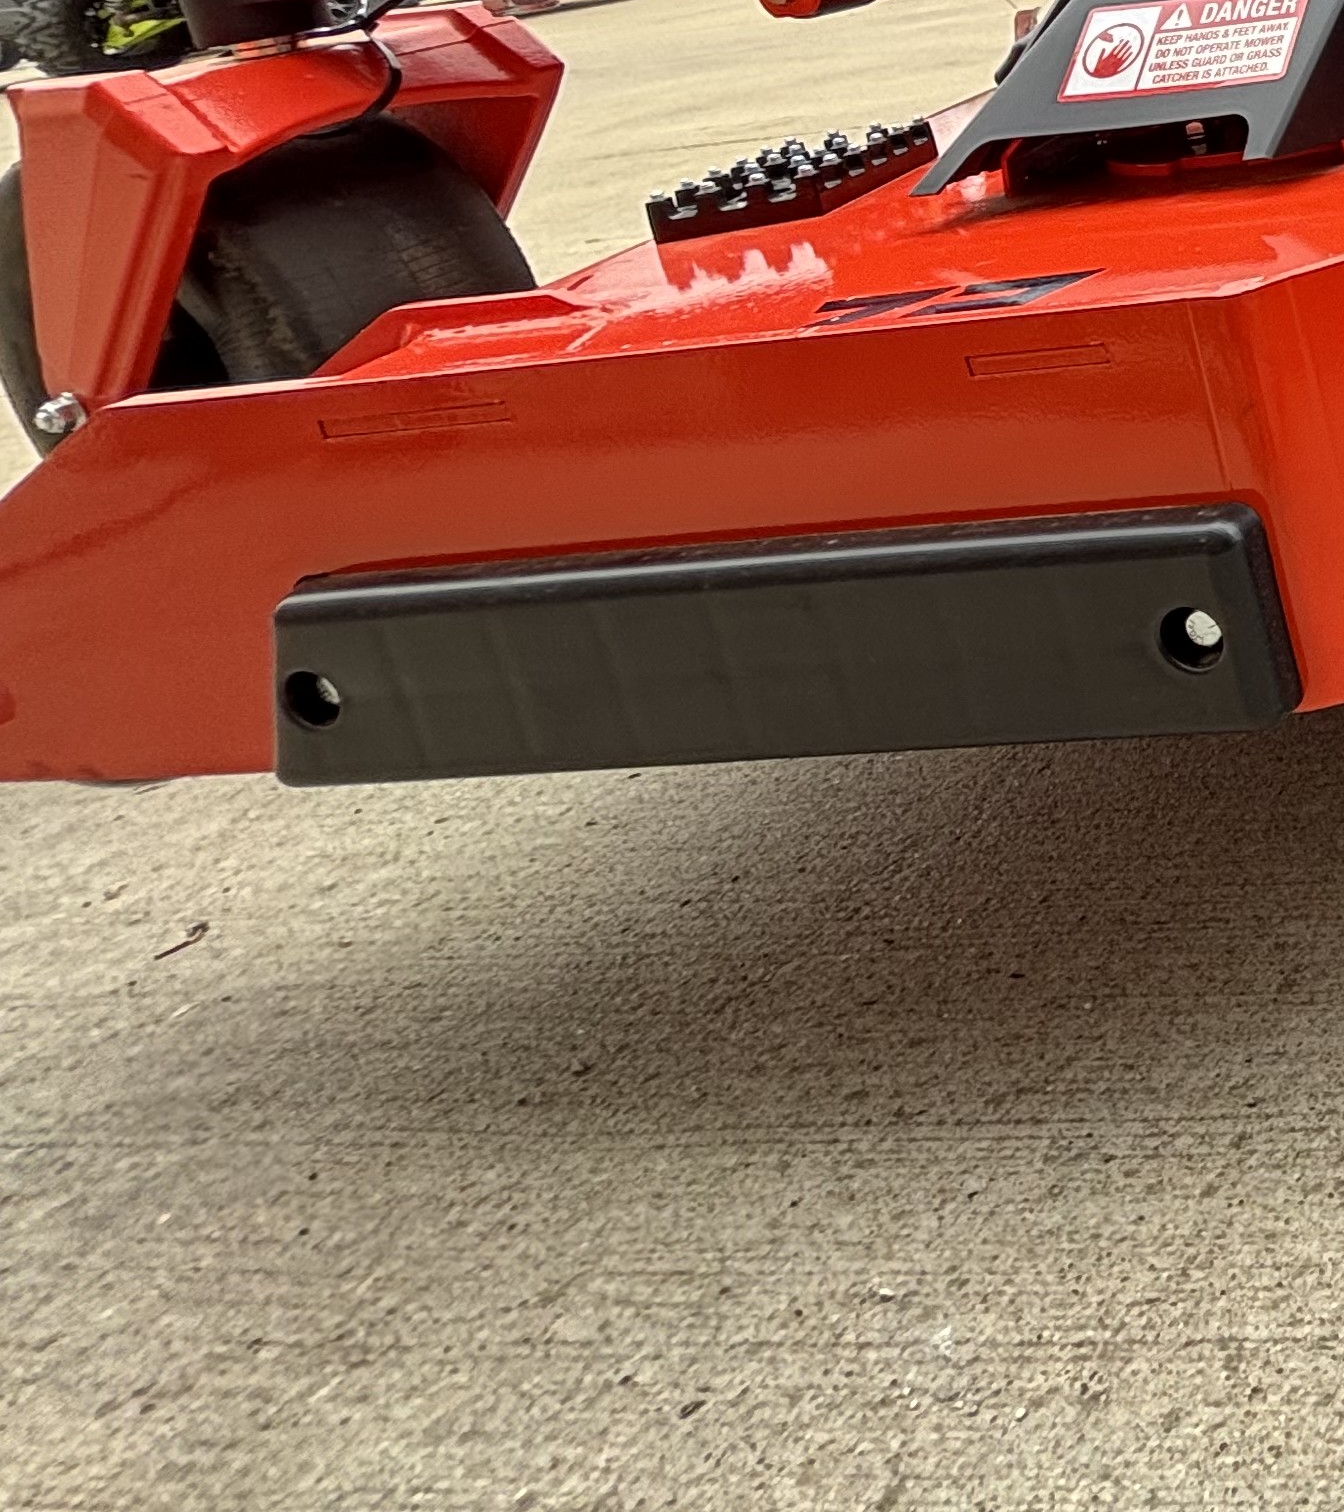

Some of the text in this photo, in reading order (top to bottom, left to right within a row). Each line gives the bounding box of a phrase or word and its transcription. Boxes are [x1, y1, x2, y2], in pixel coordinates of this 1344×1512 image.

[1154, 34, 1285, 59] DO NOT OPERATE MOWER
[1156, 34, 1183, 46] KEEP
[1184, 29, 1220, 42] HANDS
[1221, 28, 1231, 39] &
[1232, 25, 1256, 37] FEET
[1148, 47, 1283, 72] UNLESS GUARD OR GRASS
[1152, 61, 1269, 84] CATCHER IS ATTACHED.
